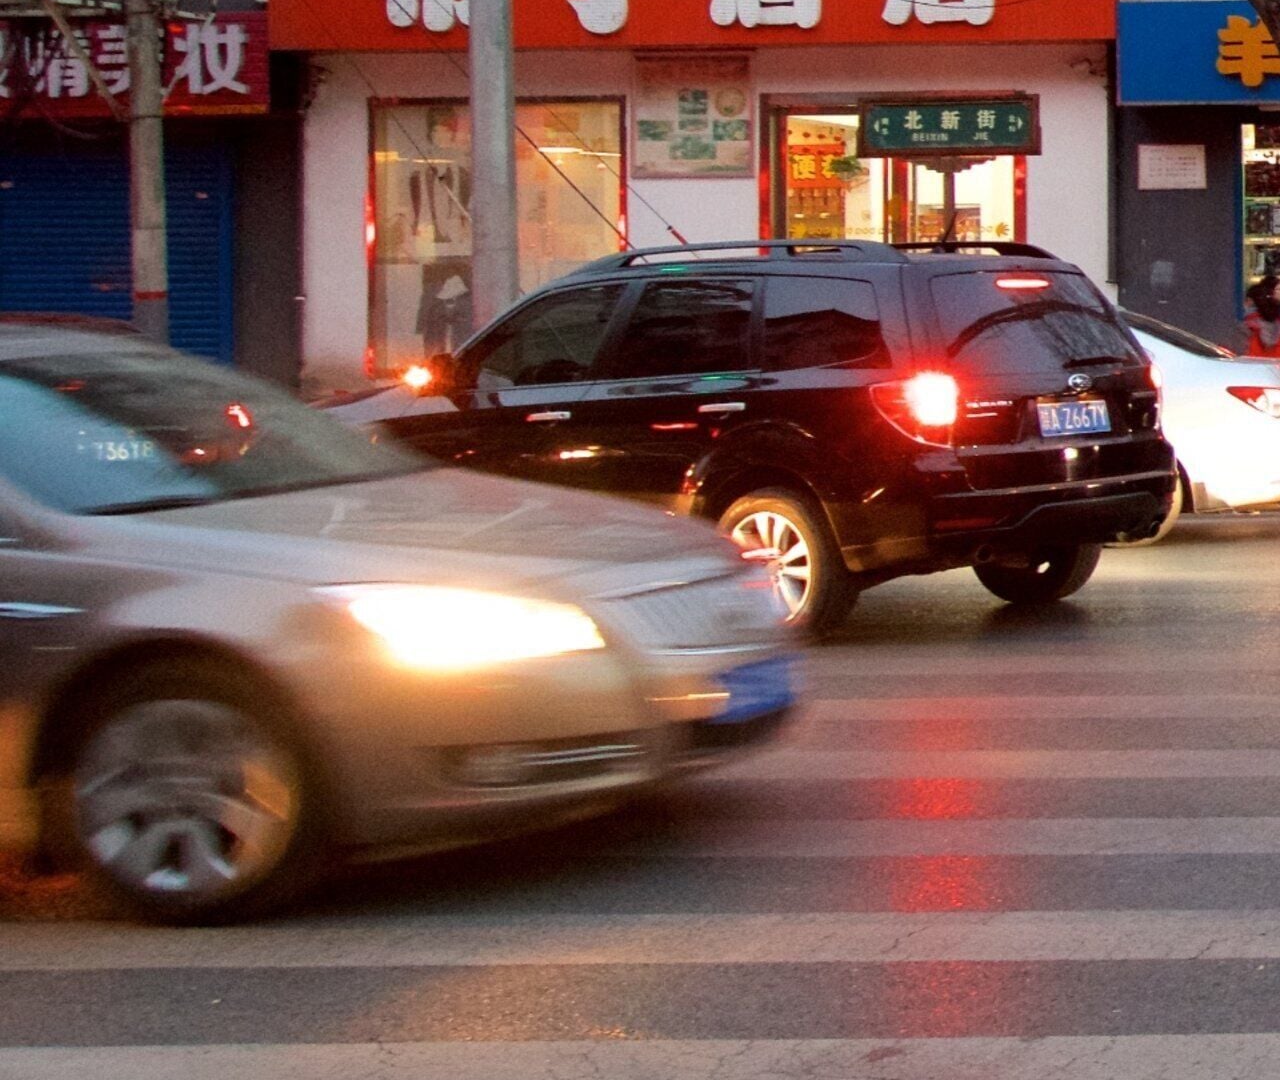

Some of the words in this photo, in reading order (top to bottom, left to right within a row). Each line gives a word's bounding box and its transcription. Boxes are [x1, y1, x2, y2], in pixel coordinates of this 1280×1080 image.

[904, 110, 995, 129] 北新街
[911, 133, 949, 142] BEIXIN
[973, 132, 988, 141] JIE
